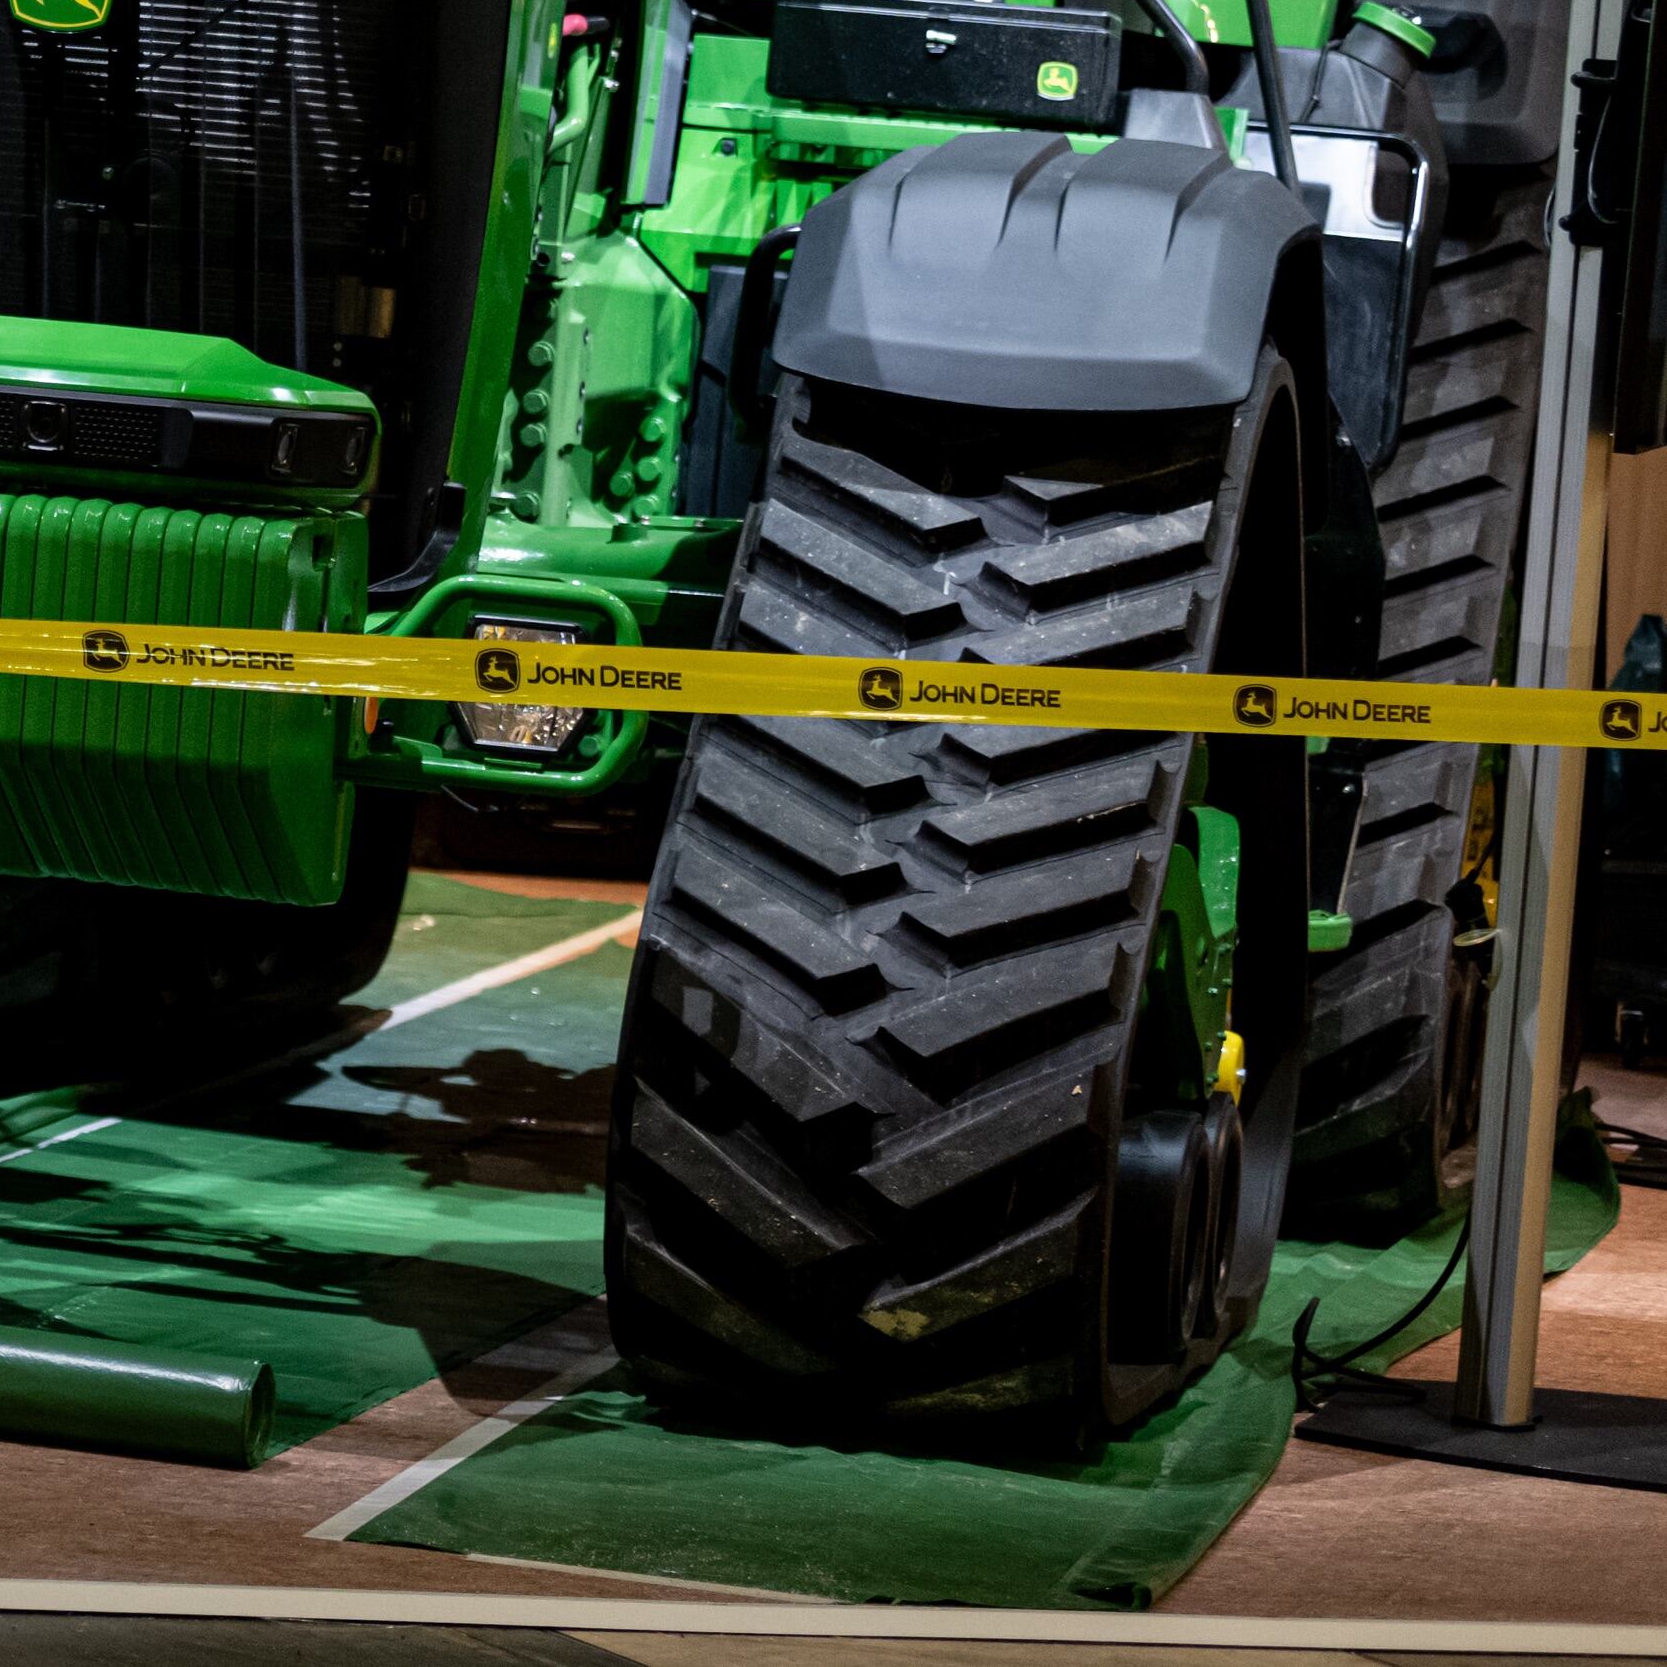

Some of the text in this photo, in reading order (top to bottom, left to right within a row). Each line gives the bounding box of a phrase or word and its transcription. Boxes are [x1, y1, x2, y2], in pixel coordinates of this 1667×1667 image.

[135, 643, 296, 672] JOHN DEERE
[527, 662, 683, 691] JOHN DEERE
[909, 680, 1062, 708] JOHN DEERE
[1283, 696, 1432, 724] JOHN DEERE
